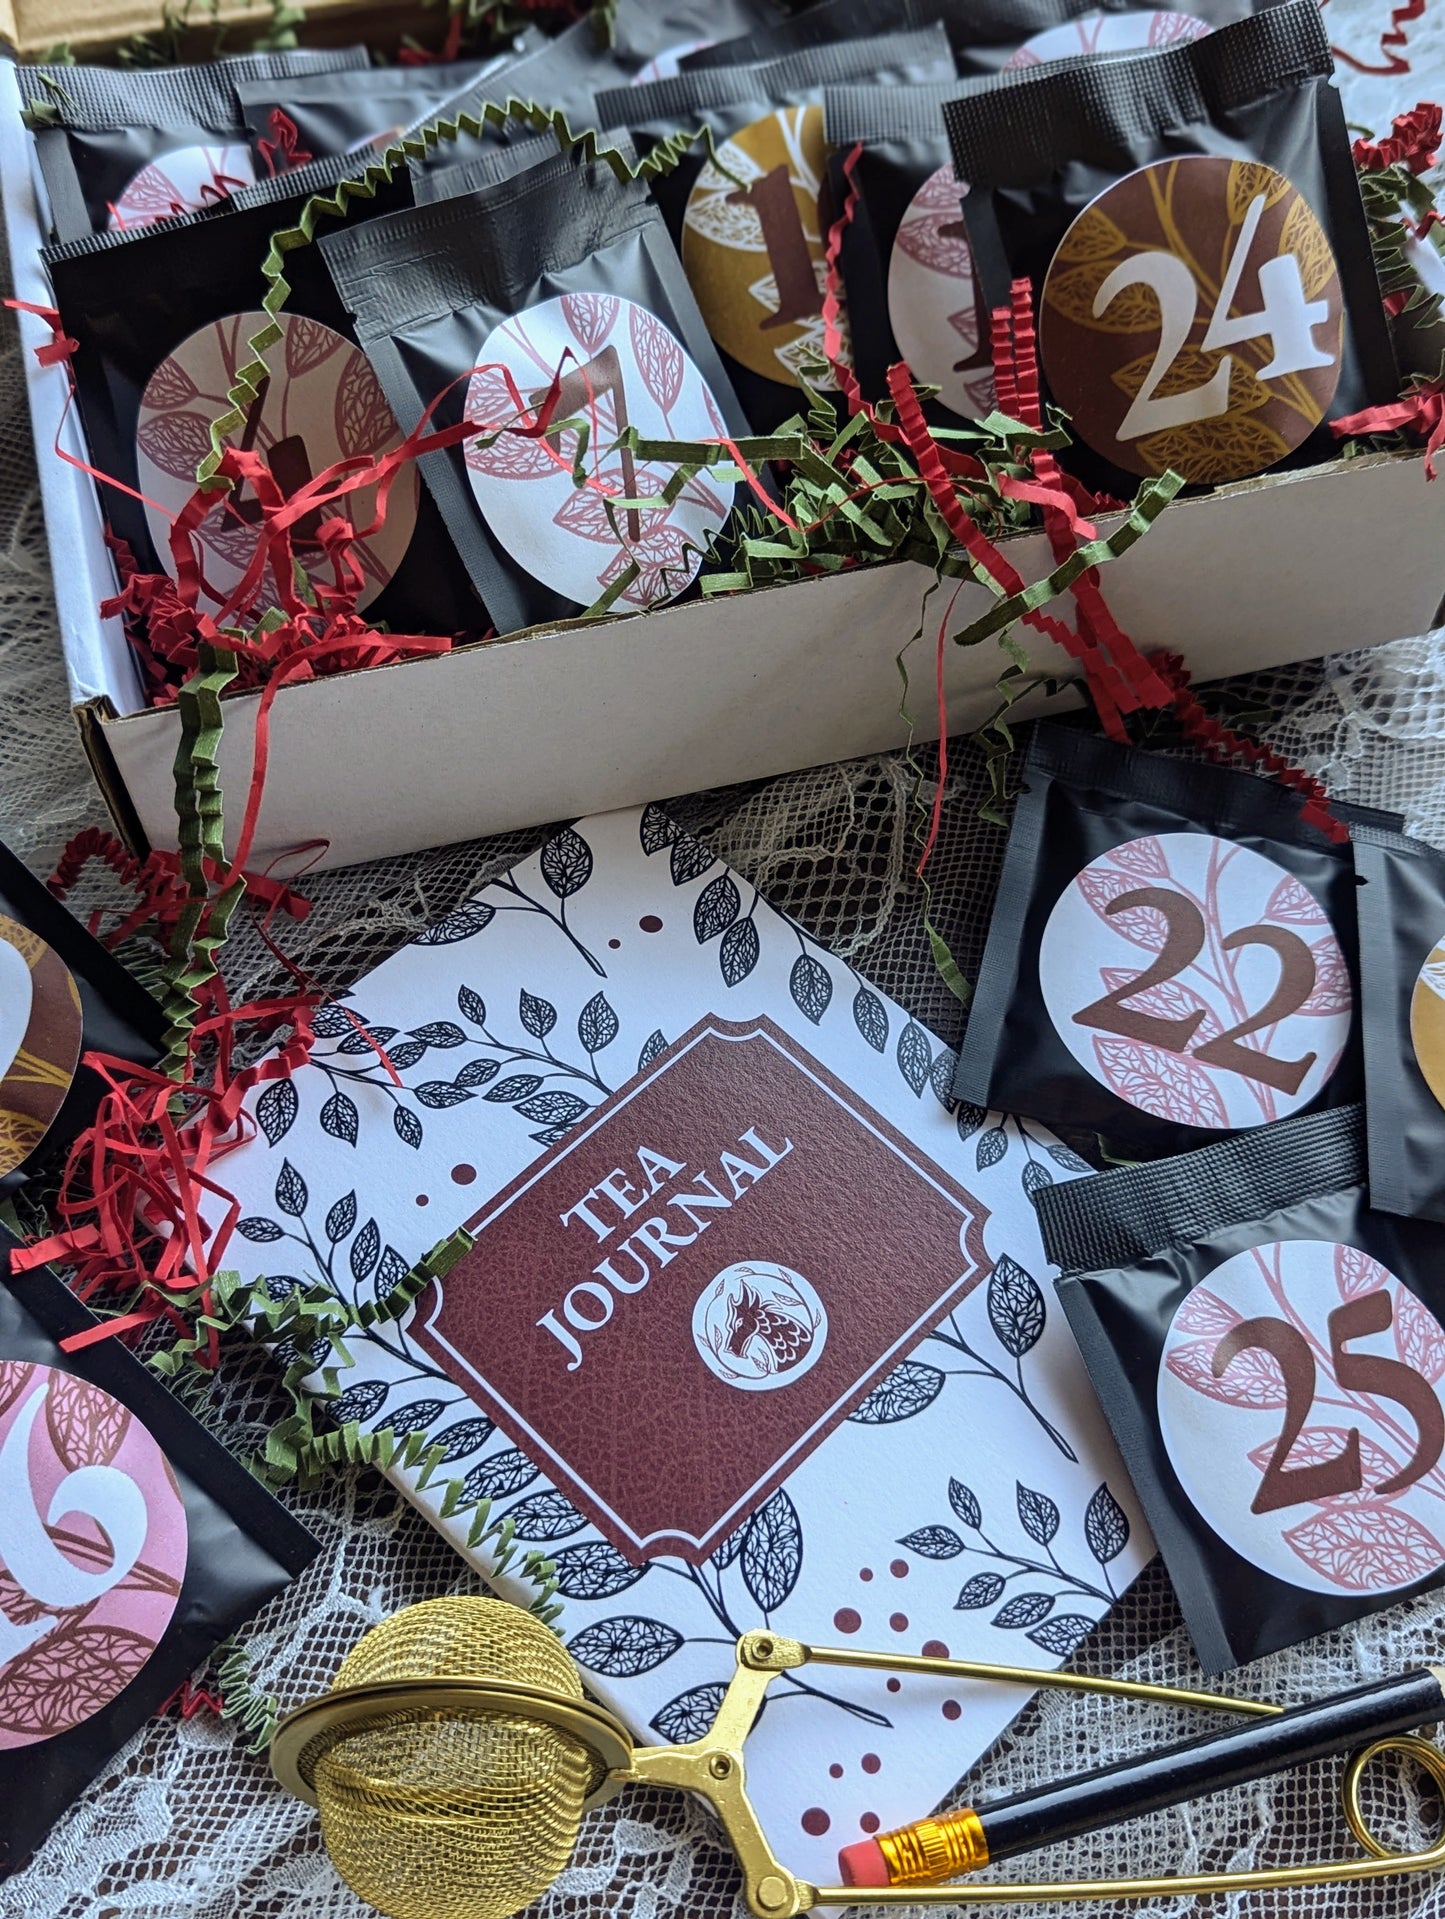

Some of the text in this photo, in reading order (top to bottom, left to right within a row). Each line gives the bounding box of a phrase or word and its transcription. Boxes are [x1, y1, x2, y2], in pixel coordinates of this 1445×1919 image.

[1091, 194, 1336, 441] 24
[529, 344, 641, 542] 7
[1071, 886, 1318, 1096] 22
[535, 1126, 794, 1372] JOURNAL
[559, 1145, 687, 1243] TEA
[1211, 1288, 1445, 1515] 25
